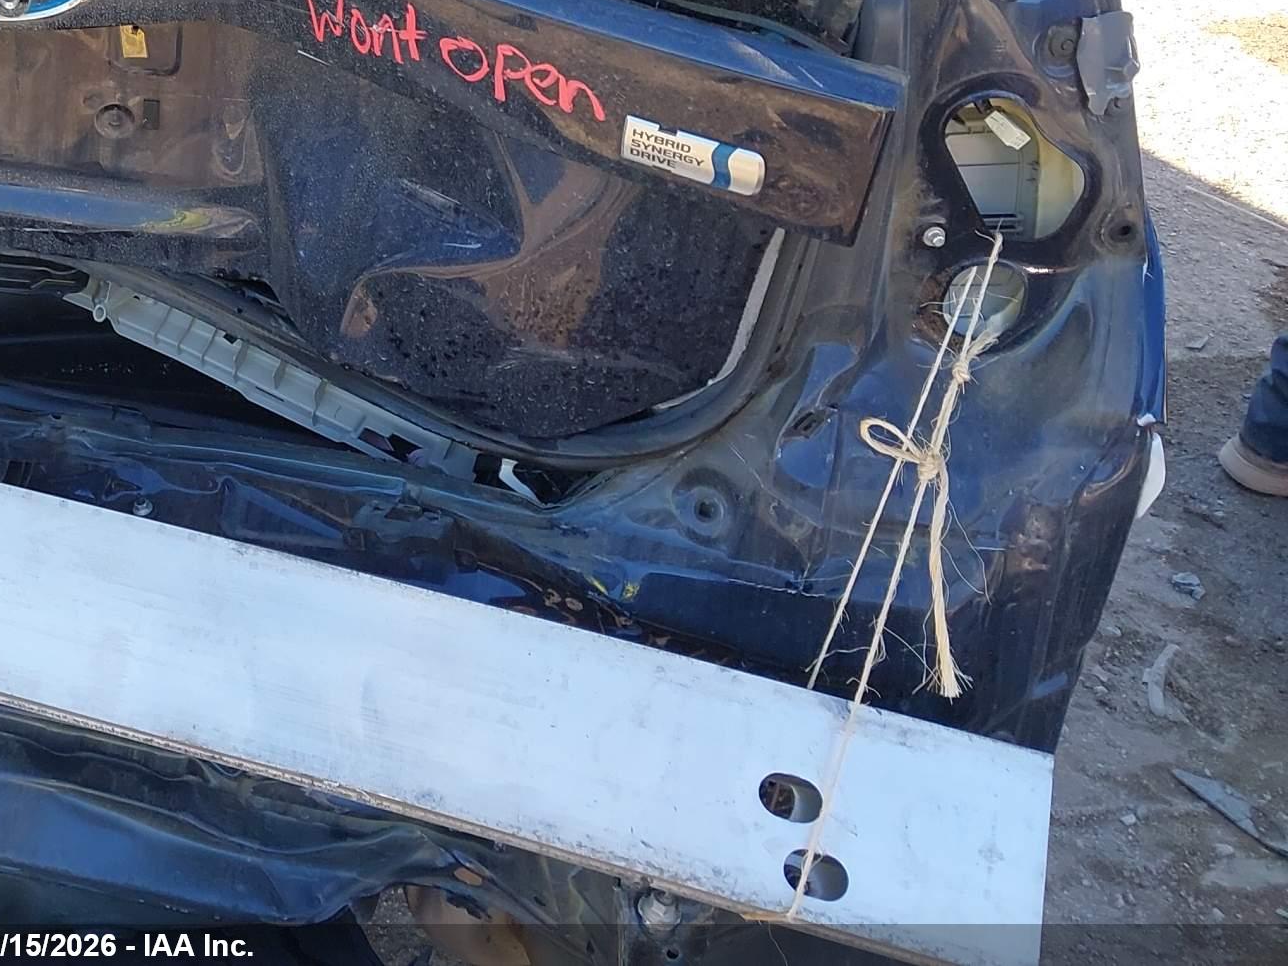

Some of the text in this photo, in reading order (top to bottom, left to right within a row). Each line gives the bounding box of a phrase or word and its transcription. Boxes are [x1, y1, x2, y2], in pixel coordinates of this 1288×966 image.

[630, 138, 705, 167] SYNERGY
[632, 129, 692, 154] HYBRID
[629, 148, 678, 169] DRIVE
